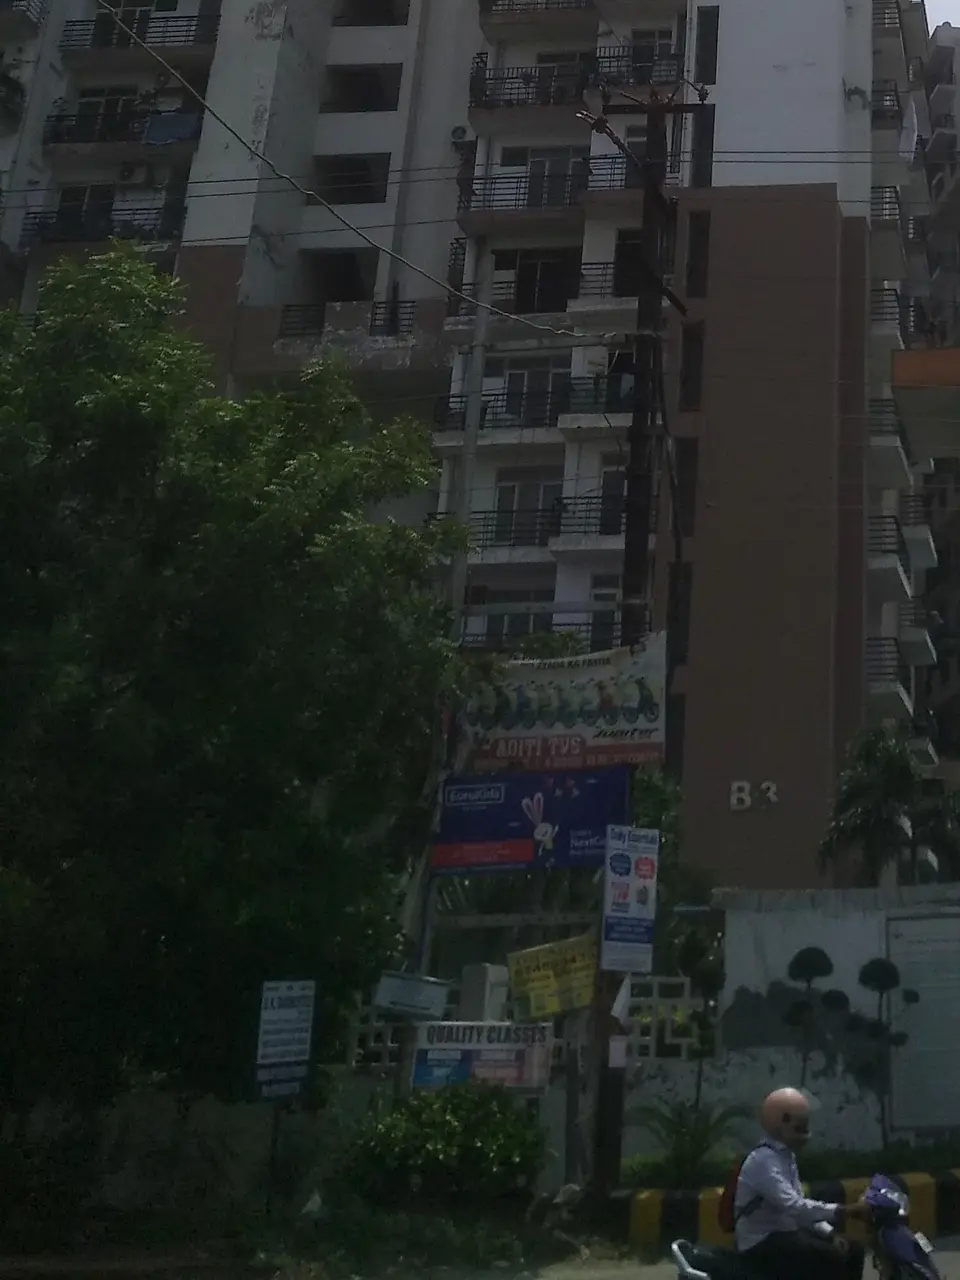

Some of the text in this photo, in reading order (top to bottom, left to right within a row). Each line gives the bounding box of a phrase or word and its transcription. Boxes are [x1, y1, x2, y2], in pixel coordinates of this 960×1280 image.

[495, 735, 583, 759] ADITI TVS
[426, 1024, 547, 1045] QUALITY CLASSES
